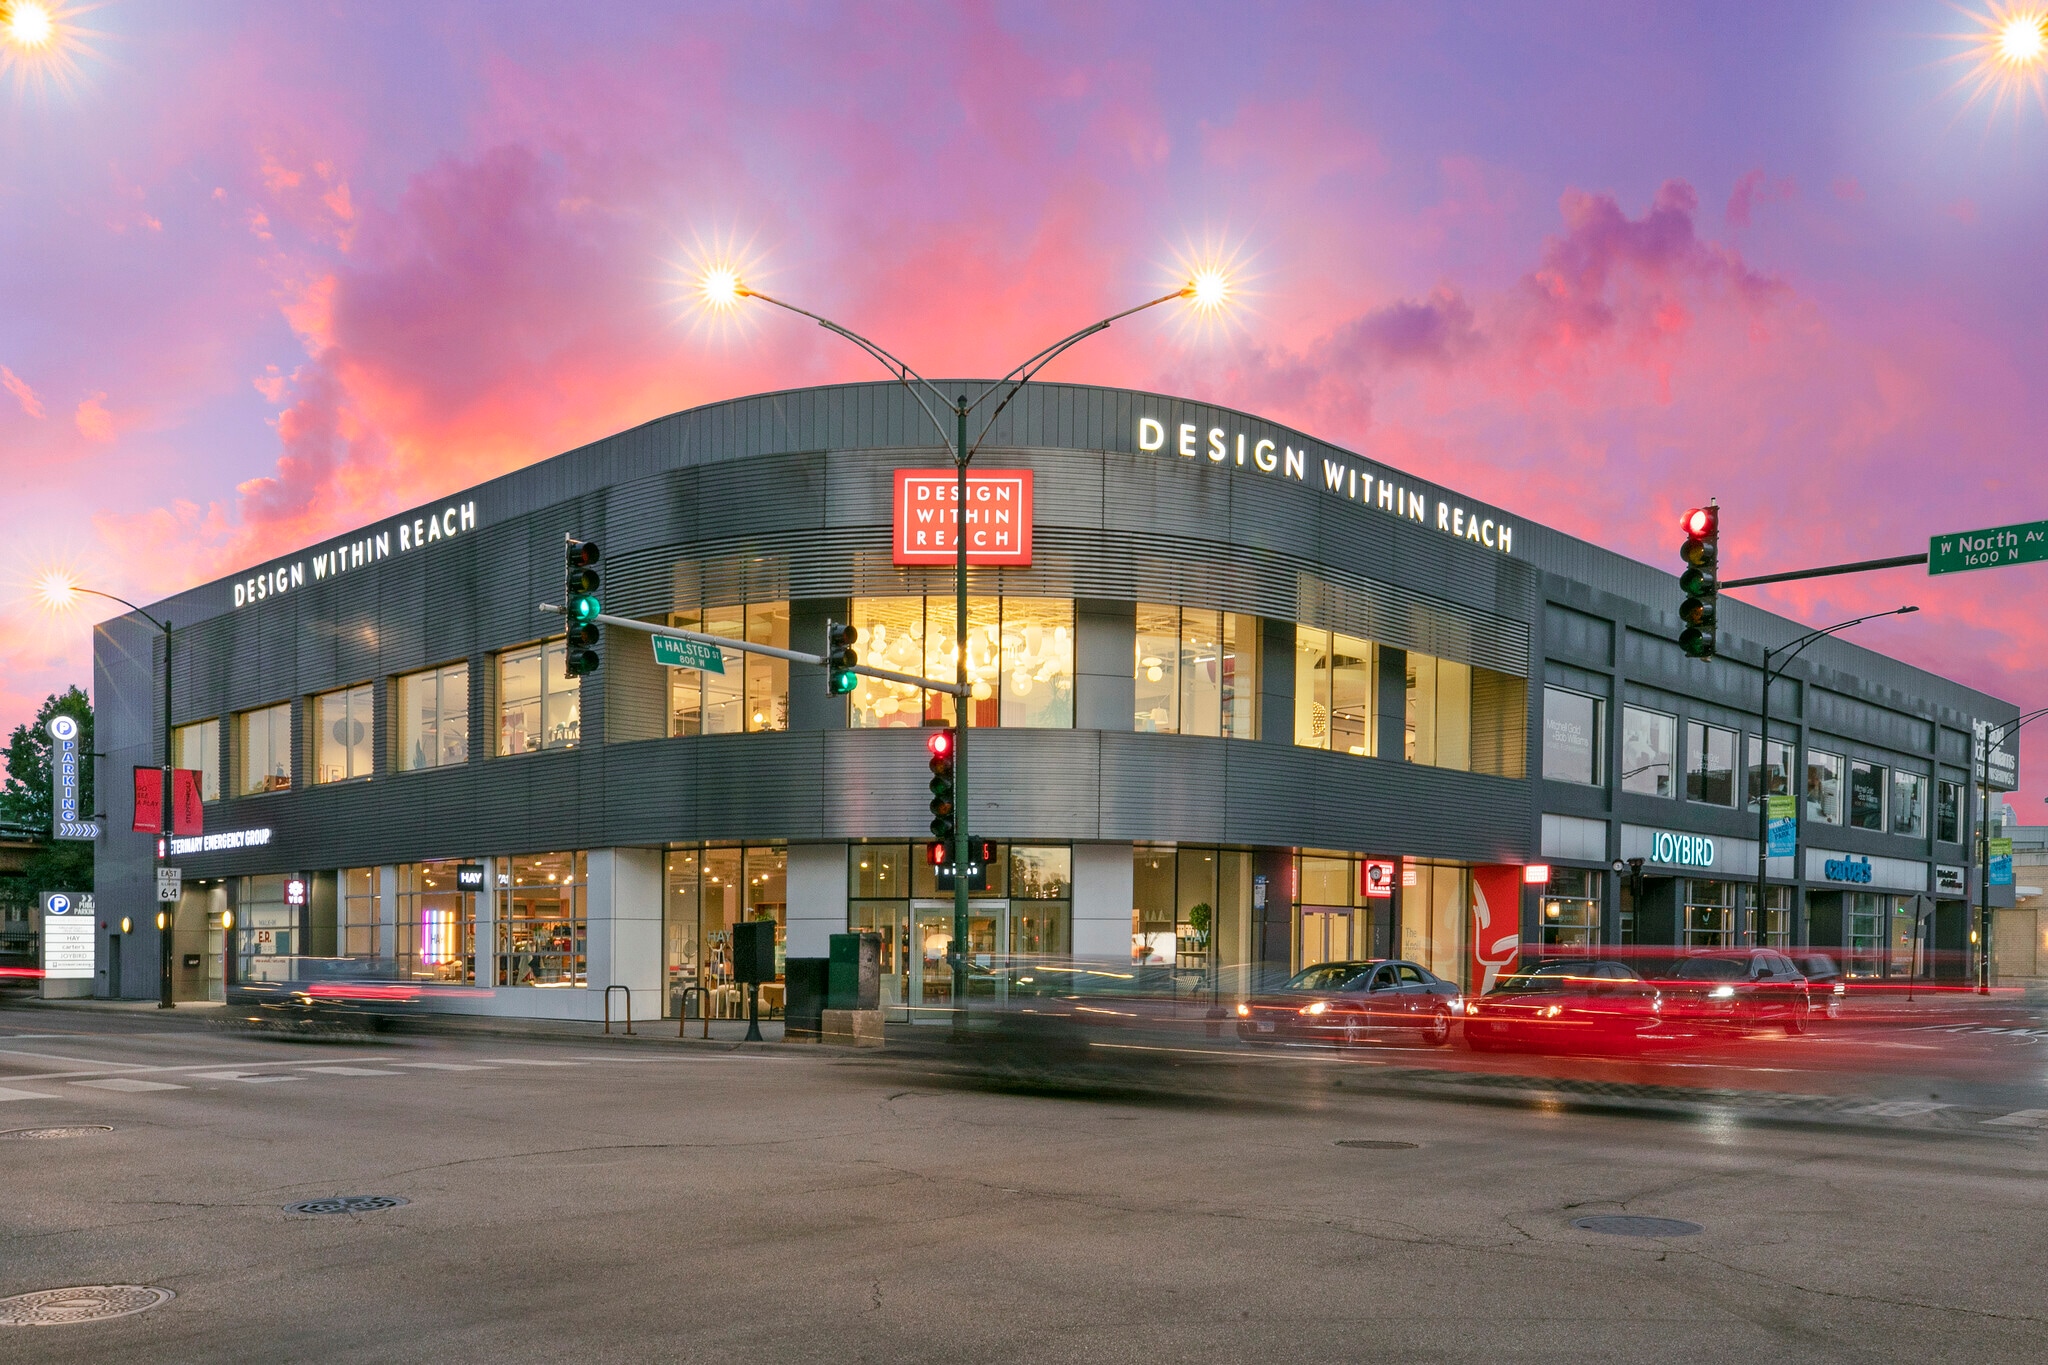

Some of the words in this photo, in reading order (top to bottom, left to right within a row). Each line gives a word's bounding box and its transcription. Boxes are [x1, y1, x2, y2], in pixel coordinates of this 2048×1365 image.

[917, 485, 1010, 502] DESIGN
[1139, 417, 1304, 480] DESIGN
[1322, 459, 1425, 524] WITHIN
[1437, 501, 1512, 554] REACH
[916, 508, 1009, 524] WITHIN
[1941, 542, 1952, 555] W
[1959, 531, 2018, 553] North
[234, 561, 303, 608] DESIGN
[313, 531, 389, 581] WITHIN
[399, 501, 475, 552] REACH
[1965, 551, 1999, 566] 1600
[2009, 548, 2018, 560] N
[657, 641, 662, 649] N
[665, 641, 710, 659] HALSTED
[712, 651, 719, 659] ST
[680, 656, 695, 665] 800
[699, 659, 705, 667] W
[62, 741, 75, 821] PARKING
[171, 837, 203, 855] ETERINARY
[204, 832, 244, 851] EMERGENCY
[245, 829, 270, 846] GROUP
[1652, 832, 1714, 867] JOYBIRD
[1825, 855, 1872, 883] carter's
[461, 873, 482, 883] HAY
[161, 888, 177, 898] 64
[288, 895, 303, 904] VEG
[258, 931, 272, 943] E.R.
[707, 930, 732, 942] HAY
[1185, 930, 1209, 943] HAY
